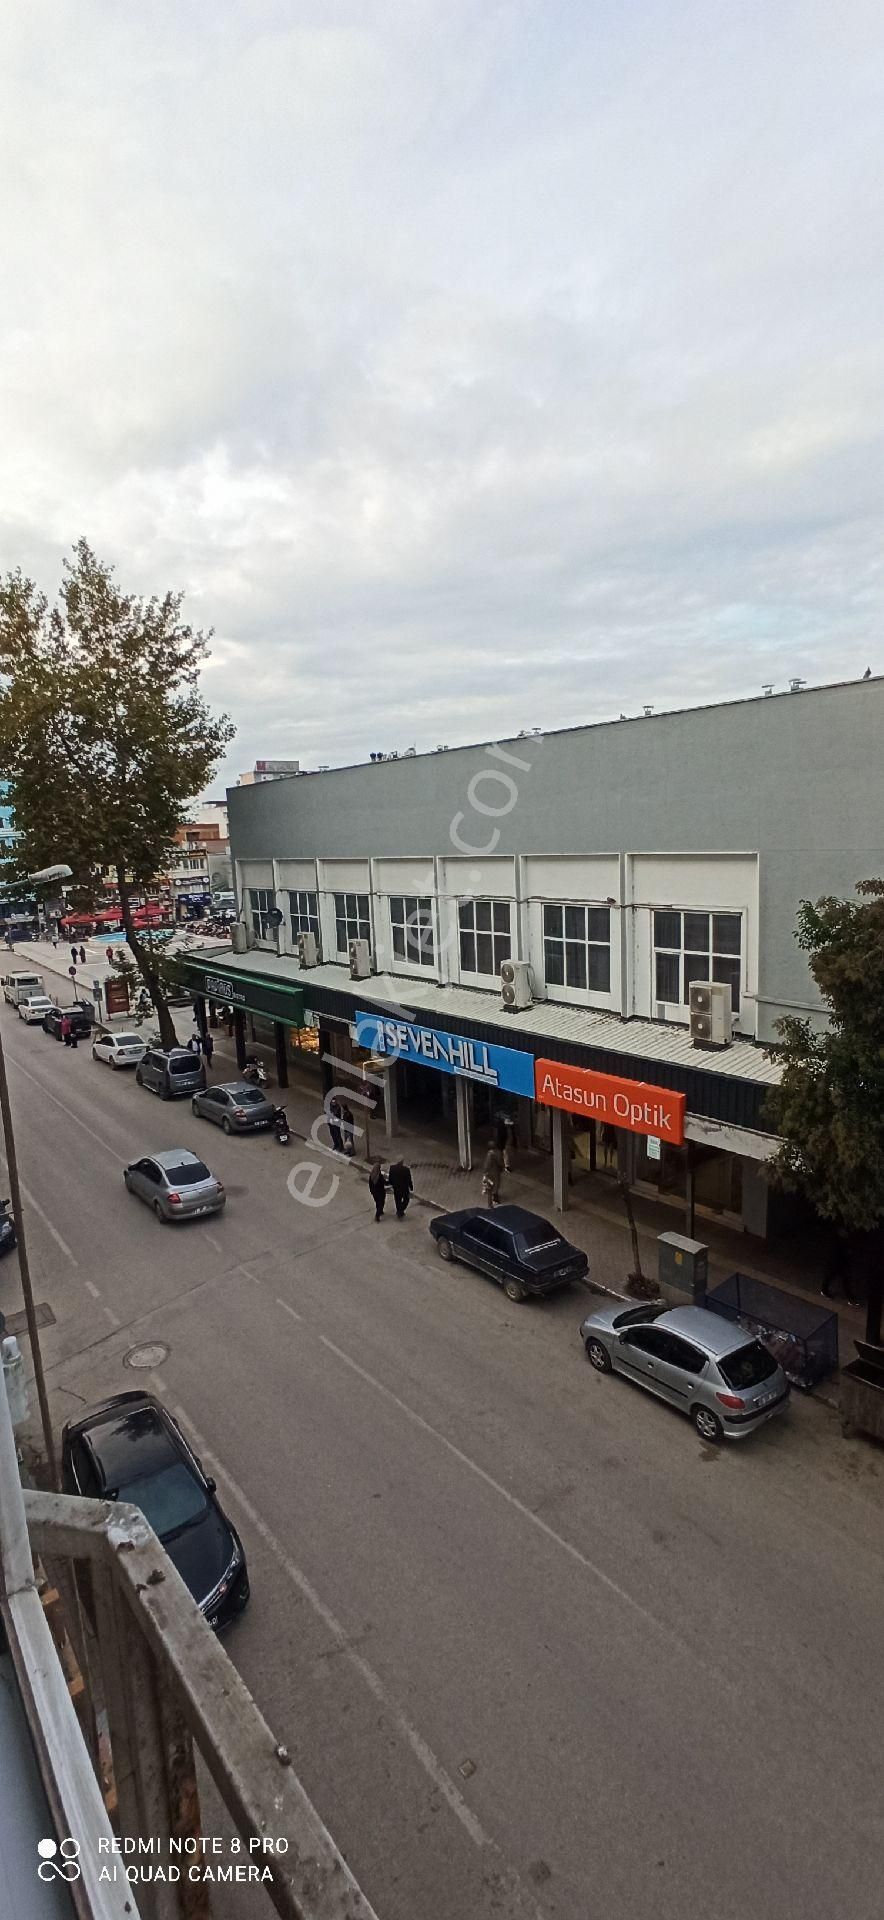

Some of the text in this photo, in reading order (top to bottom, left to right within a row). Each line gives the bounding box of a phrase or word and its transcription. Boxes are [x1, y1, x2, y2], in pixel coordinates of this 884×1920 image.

[384, 1021, 498, 1077] SEVENHILL
[542, 1074, 607, 1112] Atasun
[613, 1093, 672, 1130] Optik
